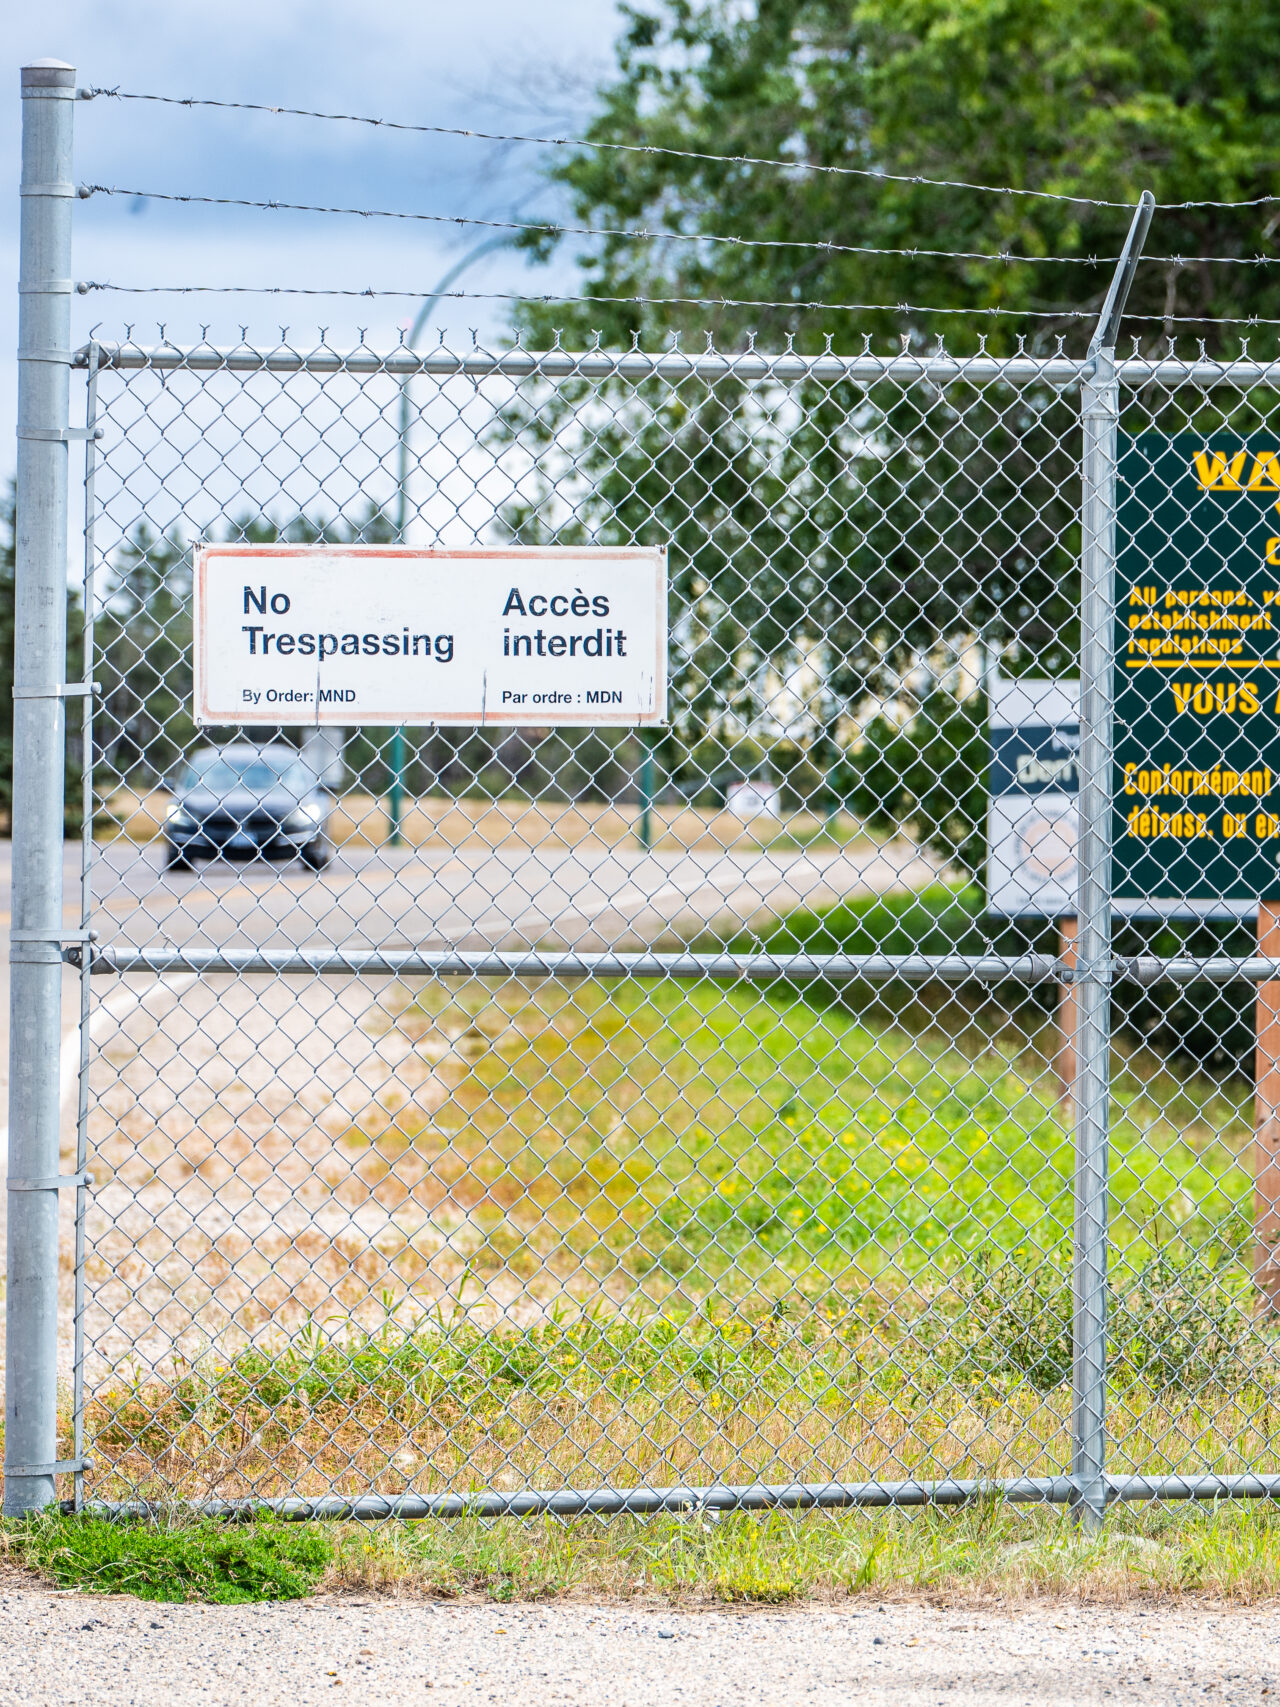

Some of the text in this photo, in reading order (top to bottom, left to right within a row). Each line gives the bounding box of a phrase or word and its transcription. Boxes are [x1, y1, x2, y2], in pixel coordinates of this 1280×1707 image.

[243, 585, 291, 615] No
[502, 587, 610, 617] Accès
[1129, 586, 1157, 607] All
[1165, 589, 1254, 608] persons,
[1128, 611, 1272, 631] establishment
[242, 626, 454, 662] Trespassing
[503, 627, 627, 657] interdit
[1128, 634, 1243, 656] regulations
[243, 689, 356, 705] By Order: MND
[502, 690, 528, 704] Par
[532, 690, 572, 704] ordre
[586, 690, 622, 704] MDN
[1171, 682, 1260, 715] VOUS
[1123, 762, 1272, 797] Conformément
[1222, 813, 1247, 839] ou
[1255, 813, 1280, 839] en
